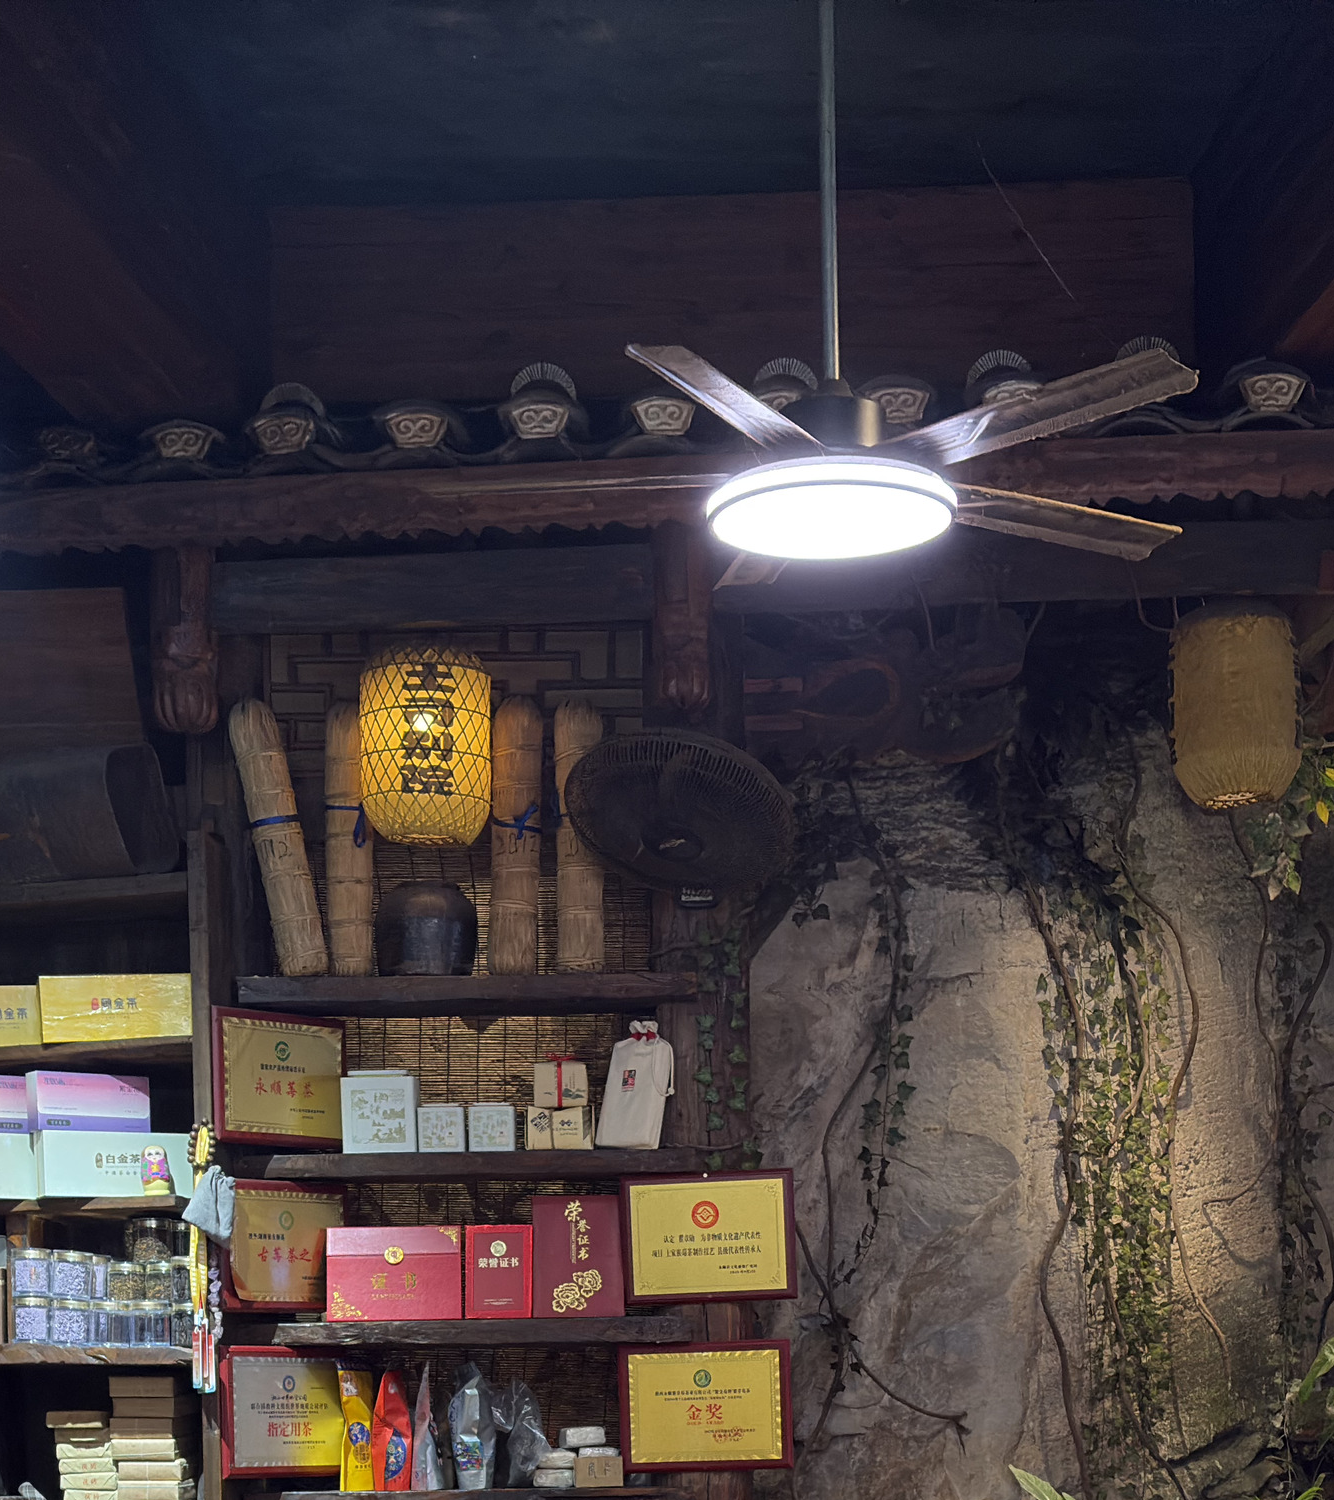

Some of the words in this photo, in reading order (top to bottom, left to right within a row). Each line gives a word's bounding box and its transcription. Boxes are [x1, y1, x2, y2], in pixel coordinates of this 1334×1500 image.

[564, 1200, 591, 1261] 荣誉证书
[478, 1257, 520, 1268] 荣誉证书
[686, 1403, 723, 1421] 金奖
[267, 1422, 313, 1437] 指定用茶
